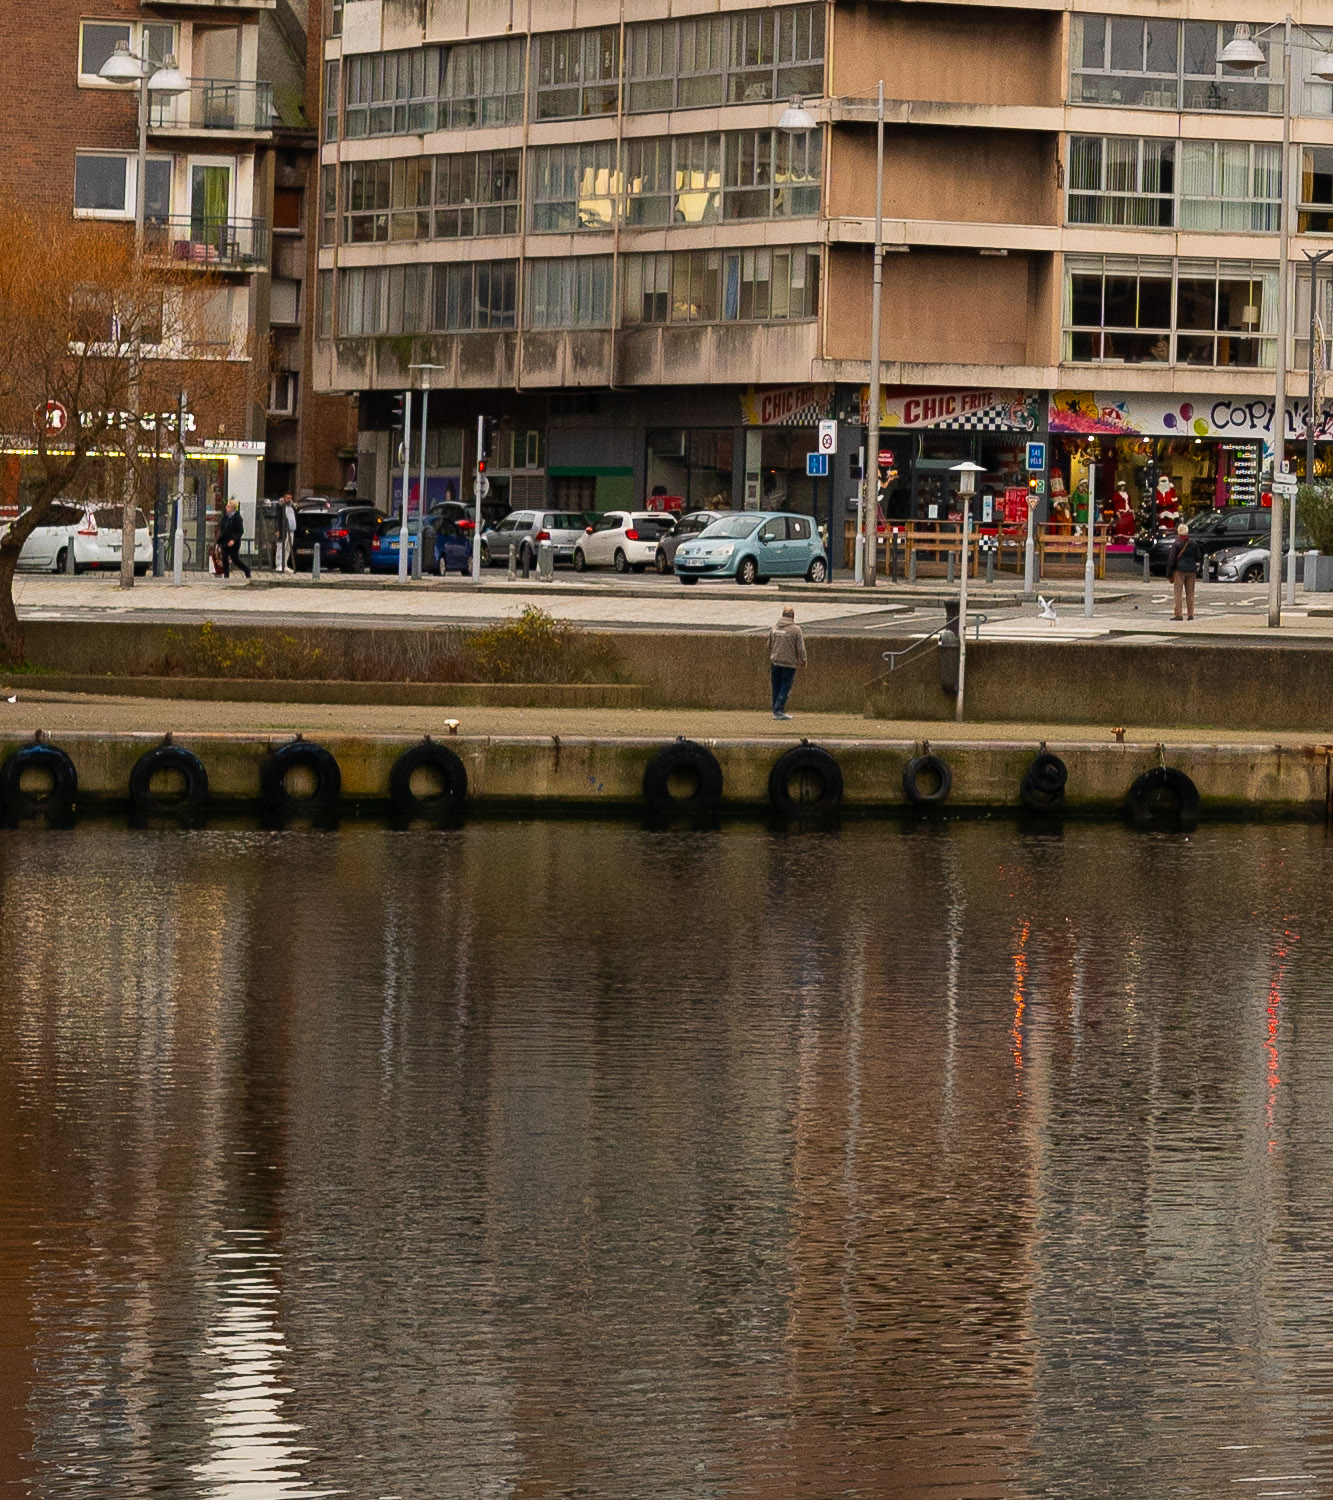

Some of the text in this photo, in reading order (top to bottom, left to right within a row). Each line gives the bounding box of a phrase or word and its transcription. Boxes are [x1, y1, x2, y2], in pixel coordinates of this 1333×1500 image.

[761, 391, 793, 424] CHIC
[904, 391, 993, 425] CHIC FRITE
